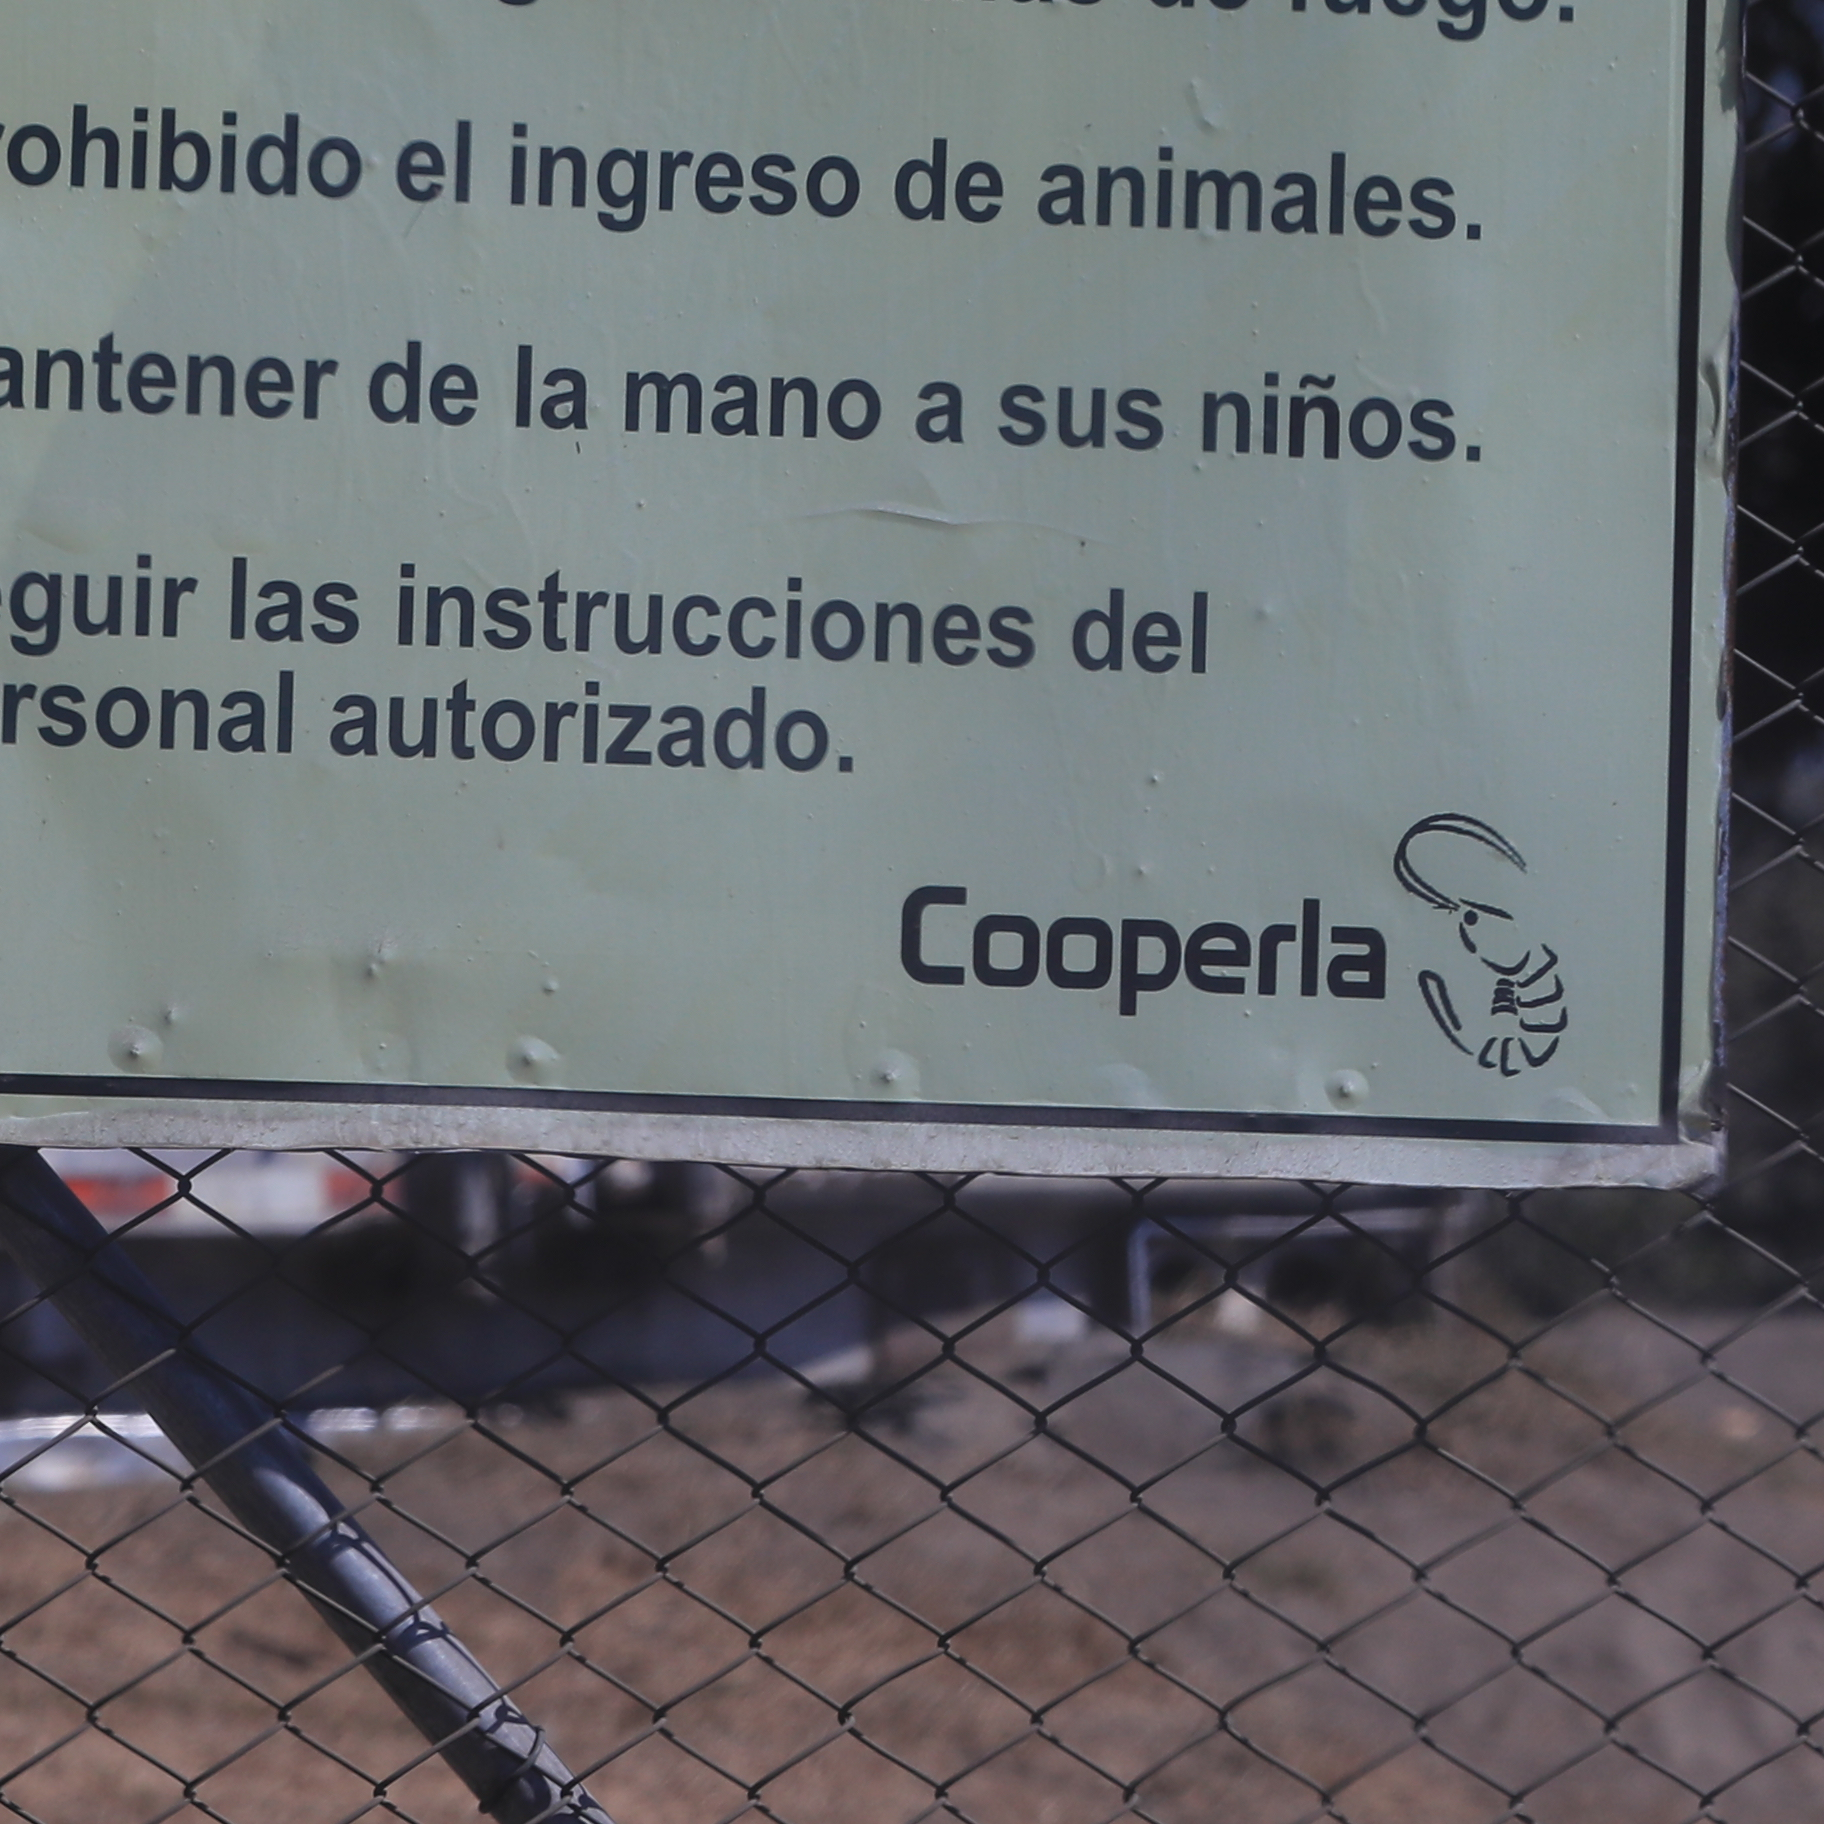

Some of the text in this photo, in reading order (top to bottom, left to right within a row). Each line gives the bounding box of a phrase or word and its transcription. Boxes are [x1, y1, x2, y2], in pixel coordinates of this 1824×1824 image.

[397, 120, 471, 202] el
[511, 123, 860, 232] ingreso
[895, 138, 1003, 223] de
[1038, 147, 1481, 240] animales.
[369, 341, 478, 426] de
[516, 345, 587, 429] la
[625, 372, 881, 440] mano
[916, 382, 963, 443] a
[998, 385, 1163, 450] sus
[1203, 372, 1480, 461] niños.
[231, 557, 359, 644] las
[398, 564, 1033, 668] instrucciones
[1070, 588, 1210, 673] del
[330, 679, 852, 772] autorizado.
[901, 886, 1386, 1016] Cooperla
